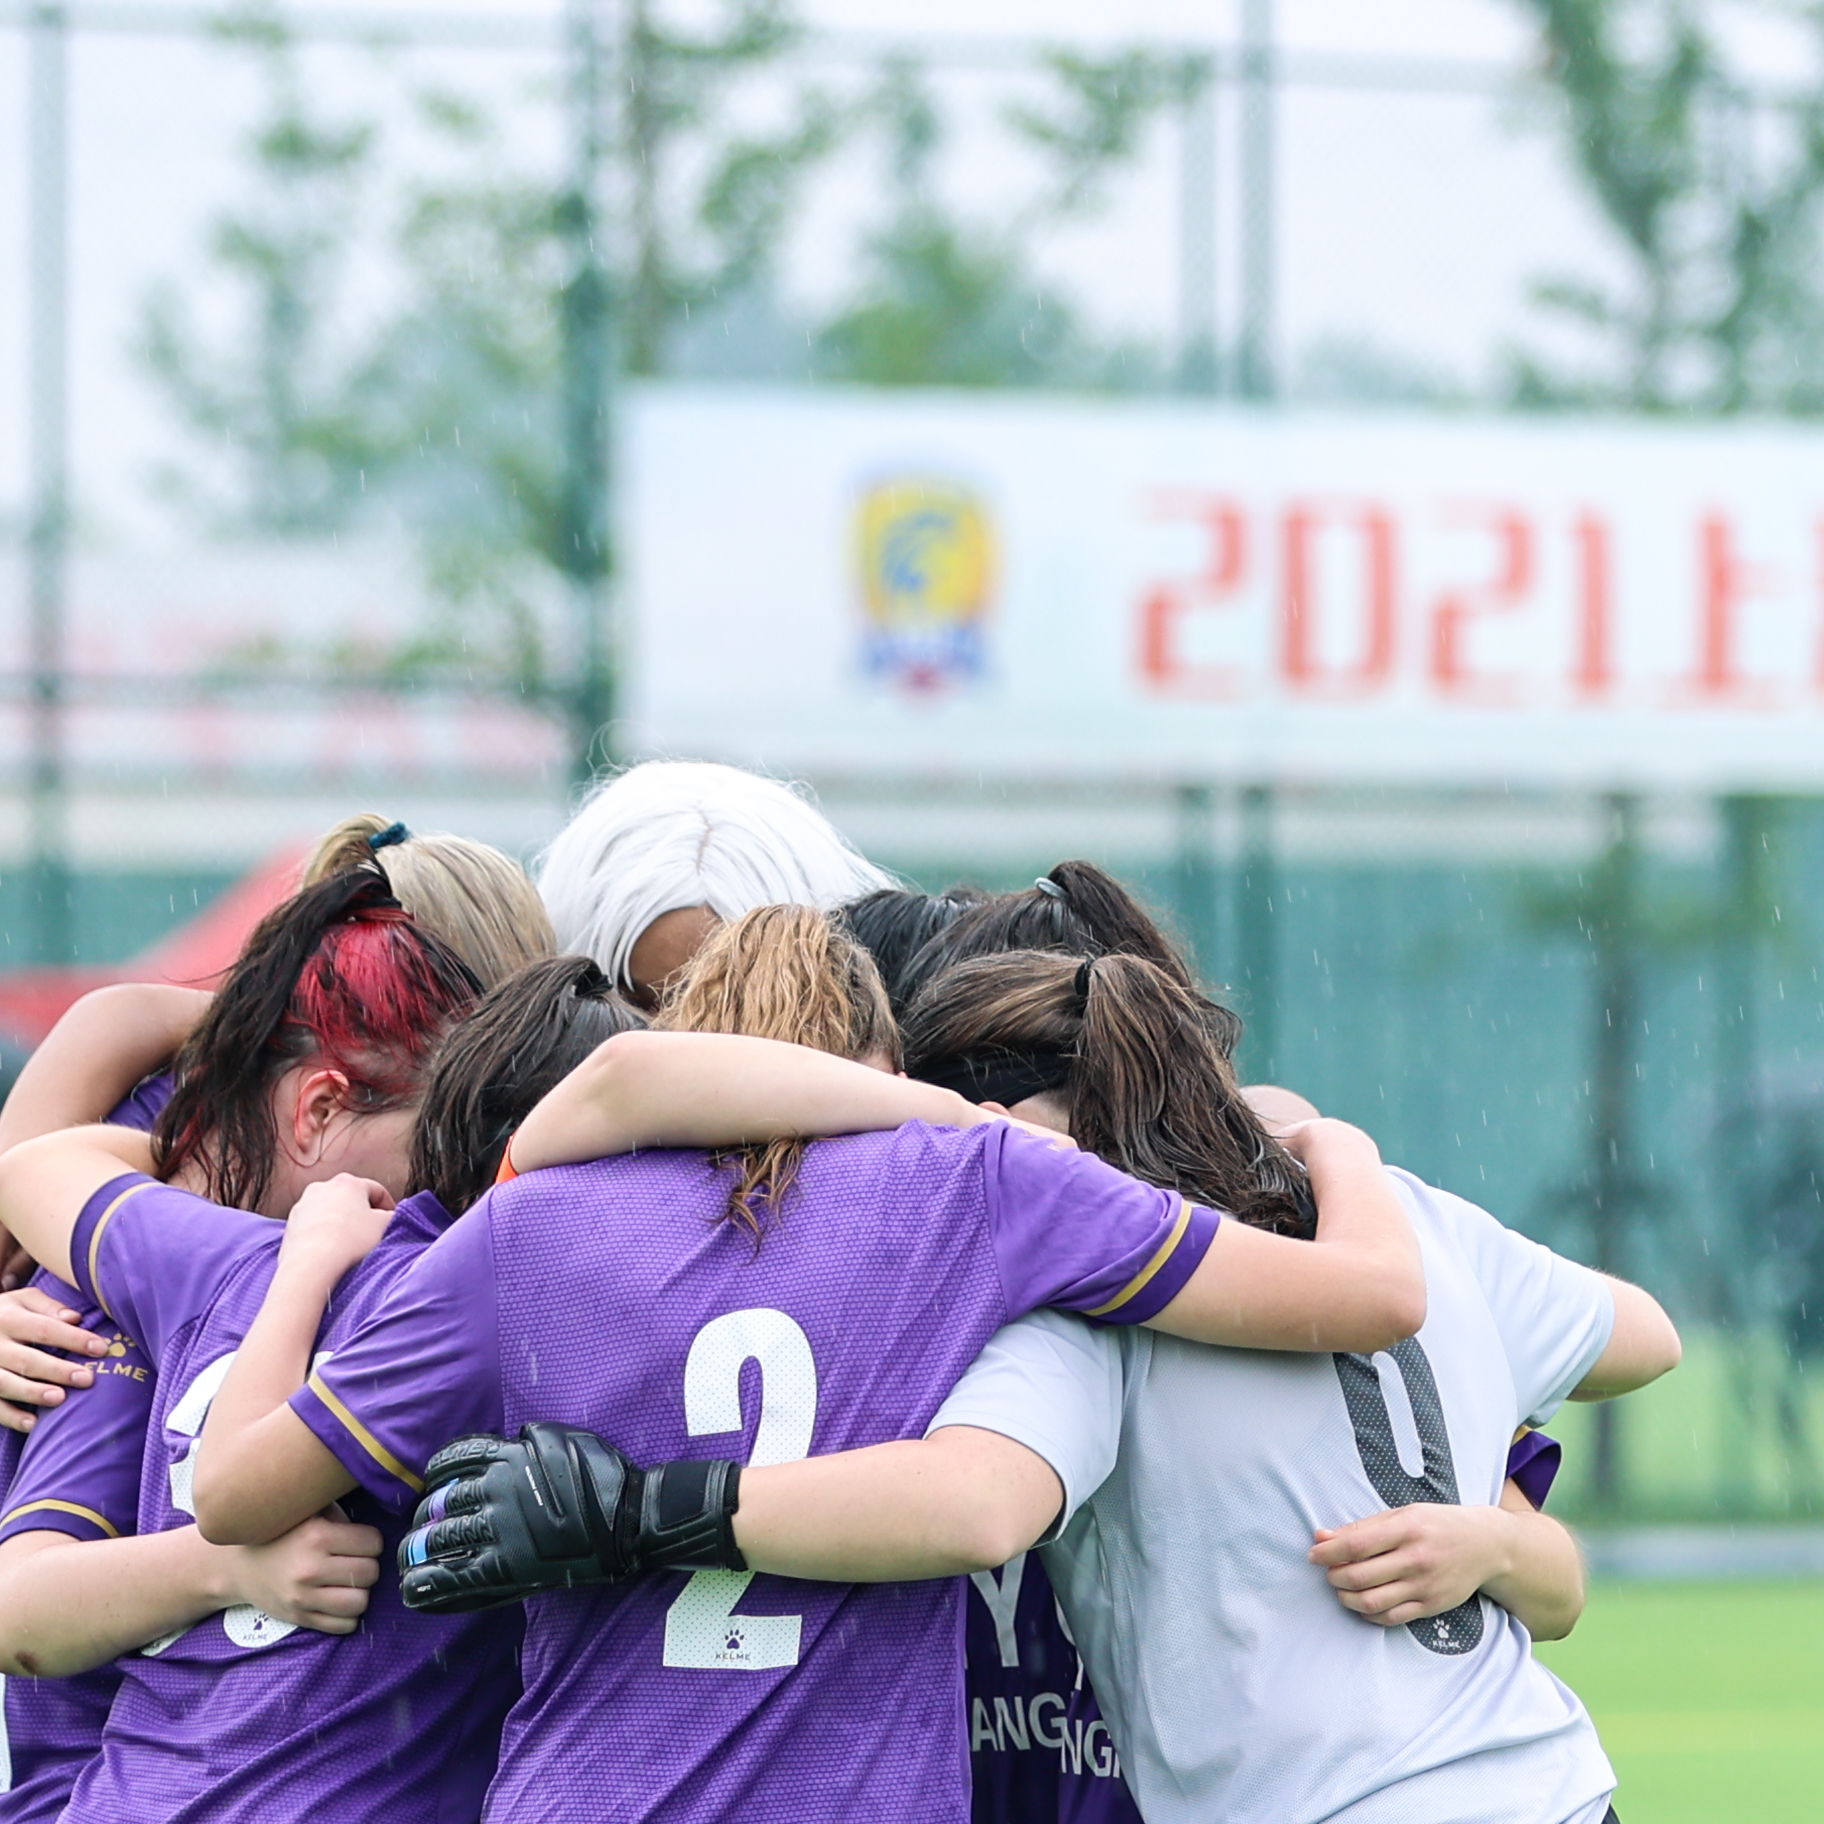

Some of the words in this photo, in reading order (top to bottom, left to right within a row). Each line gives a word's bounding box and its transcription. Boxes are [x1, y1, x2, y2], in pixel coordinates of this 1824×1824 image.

[85, 1361, 149, 1383] ELME
[664, 1308, 817, 1669] 2
[715, 1651, 751, 1661] KELME
[972, 1692, 1067, 1752] ANG
[1060, 1717, 1121, 1778] NG
